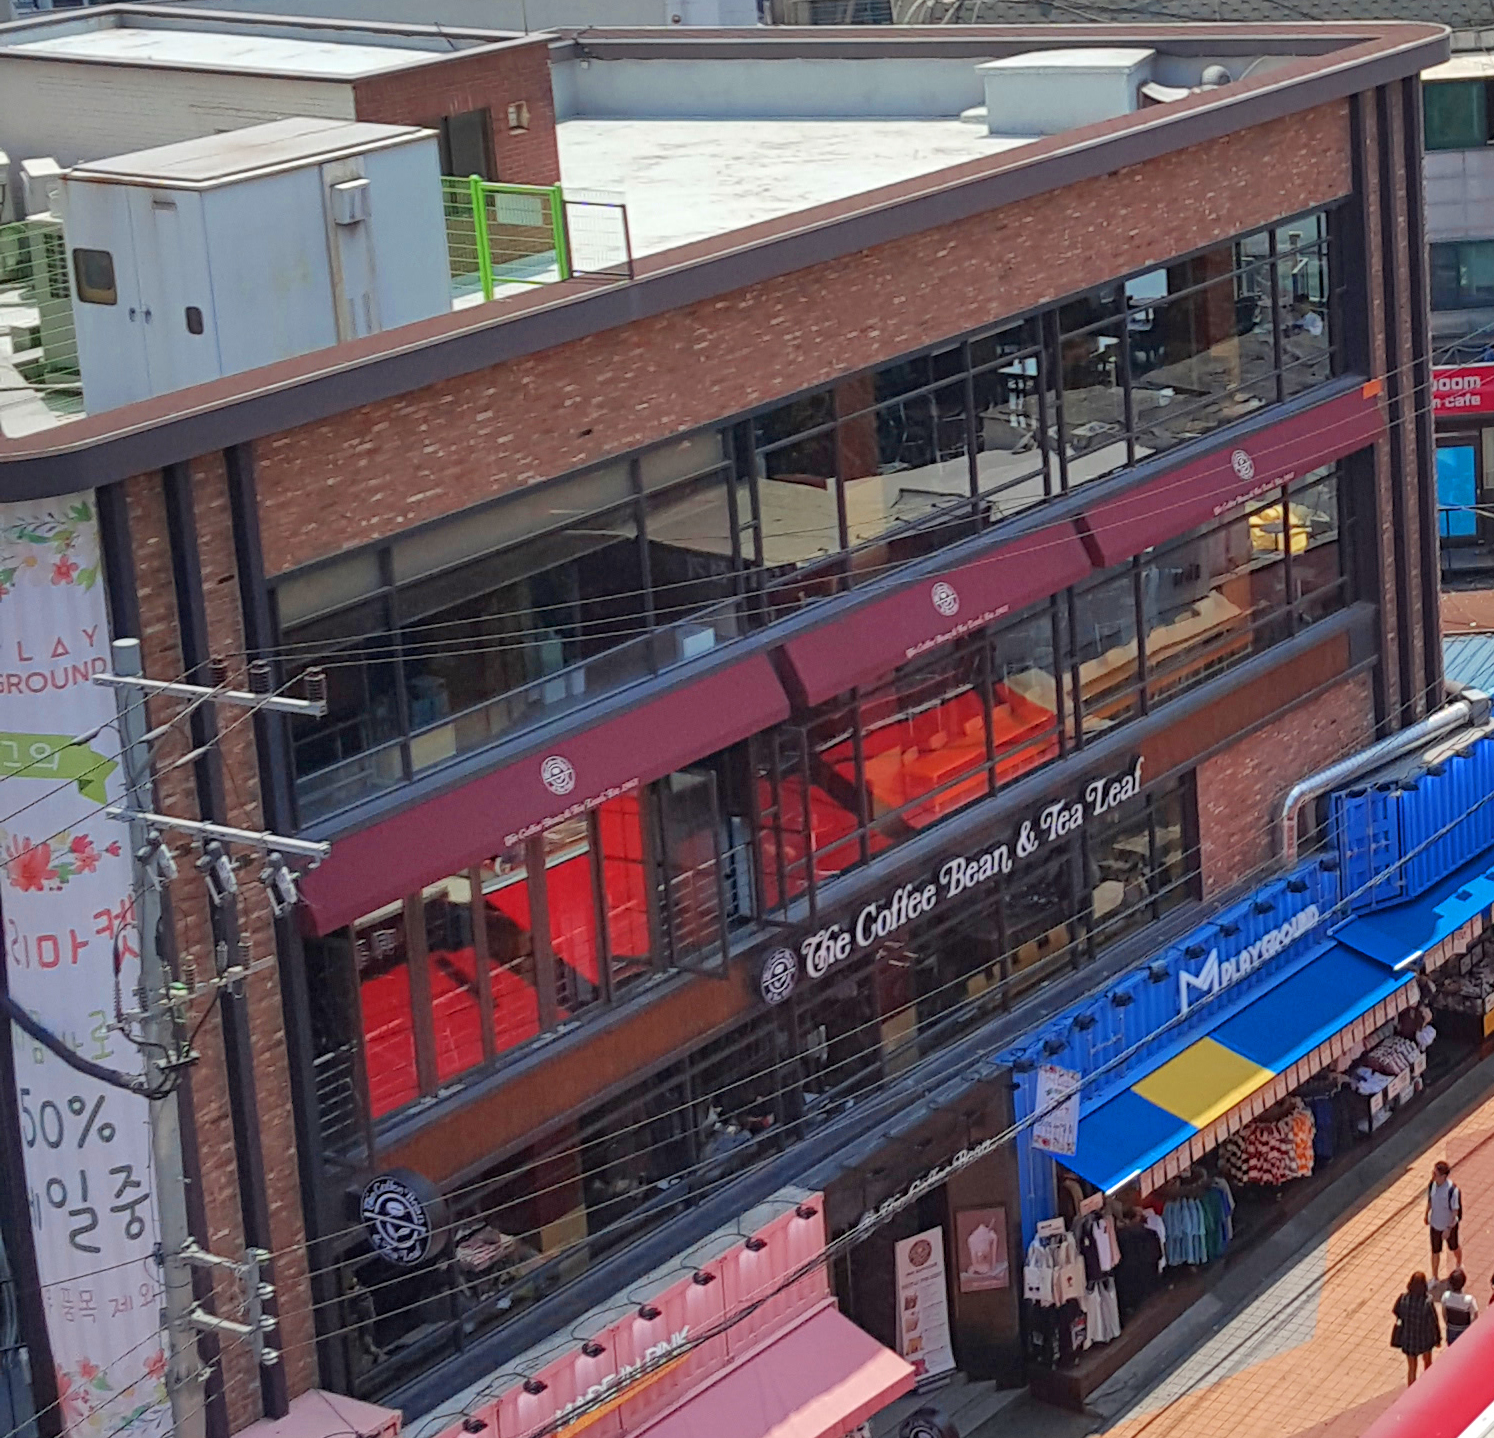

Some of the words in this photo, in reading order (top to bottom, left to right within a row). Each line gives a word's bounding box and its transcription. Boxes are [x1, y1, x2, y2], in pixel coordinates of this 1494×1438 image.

[1445, 394, 1481, 407] cafe
[801, 932, 853, 980] The
[855, 882, 938, 947] Coffee
[939, 843, 1013, 904] Bean
[1015, 819, 1039, 860] &
[1039, 798, 1084, 845] Tea
[1085, 755, 1145, 818] Leaf
